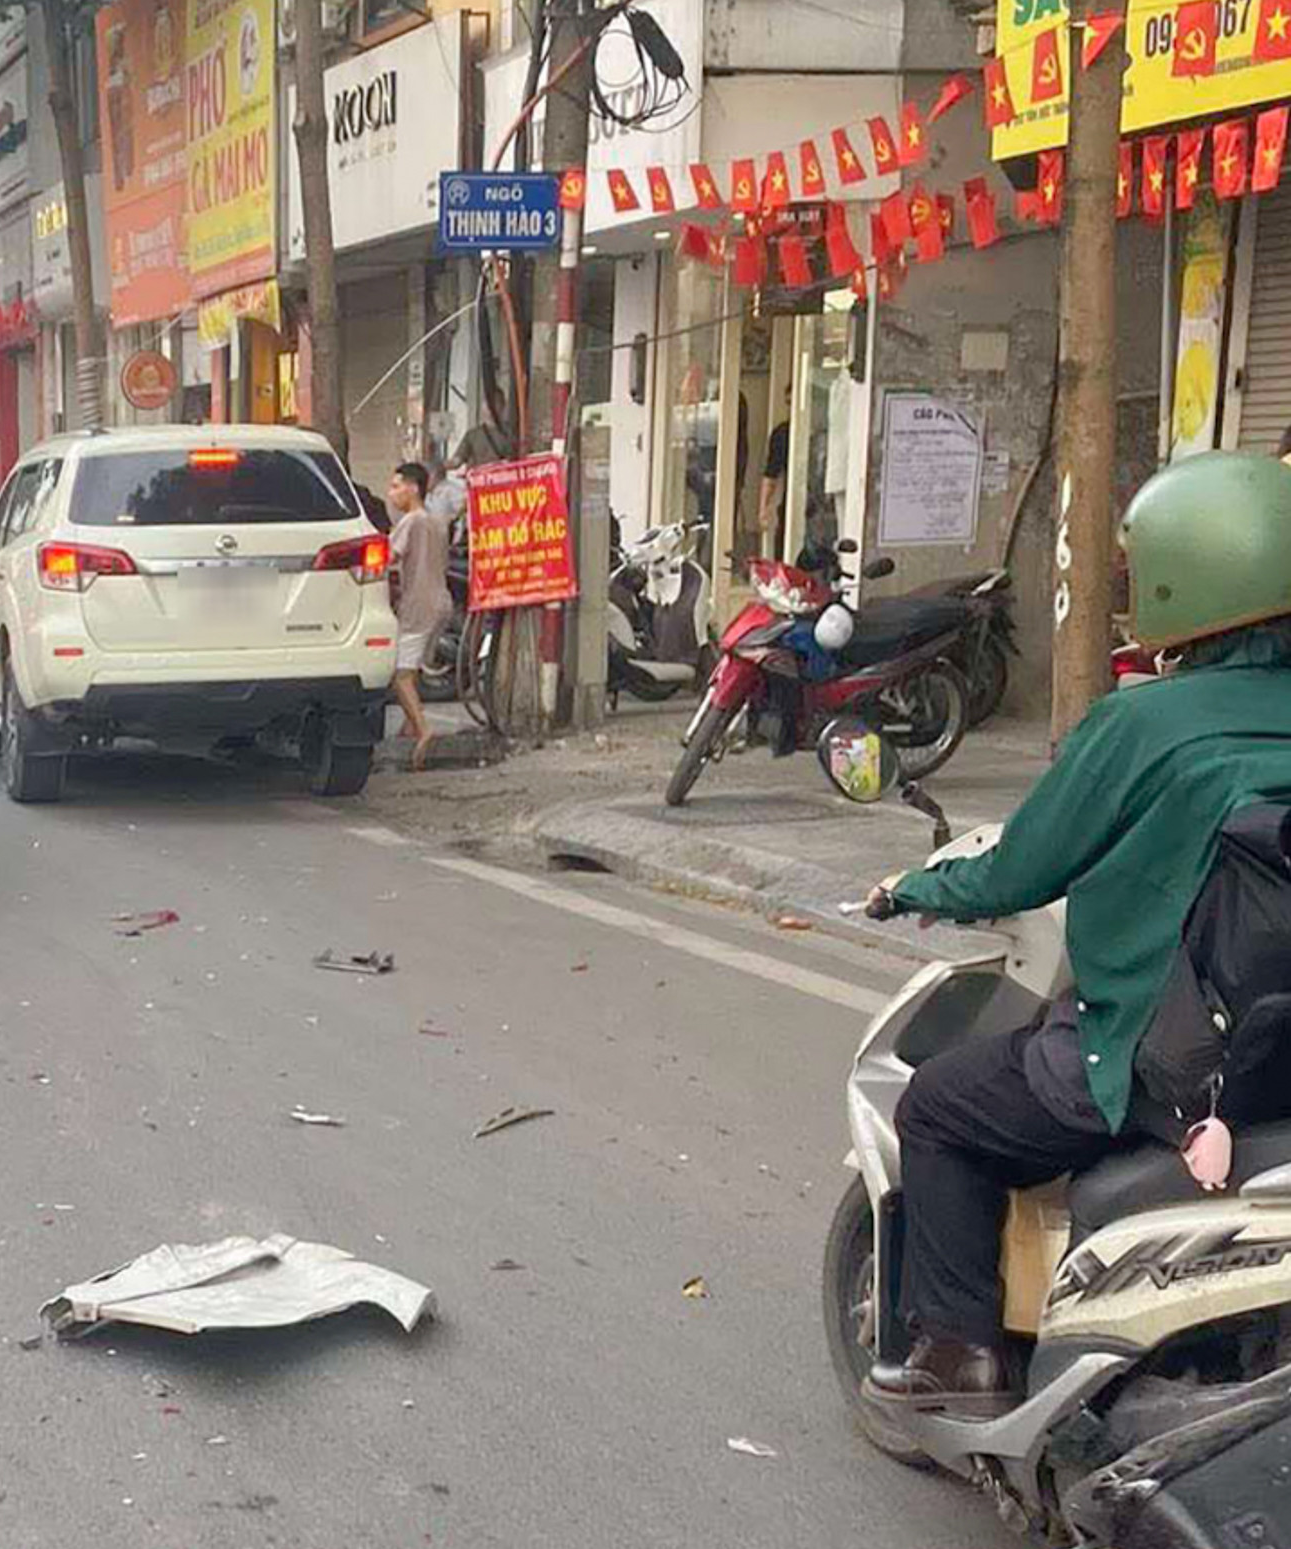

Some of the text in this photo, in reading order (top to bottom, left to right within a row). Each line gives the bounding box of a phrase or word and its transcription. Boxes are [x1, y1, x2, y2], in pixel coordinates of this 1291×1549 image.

[448, 204, 556, 242] THỊNH HÀO 3
[479, 490, 512, 515] KHU
